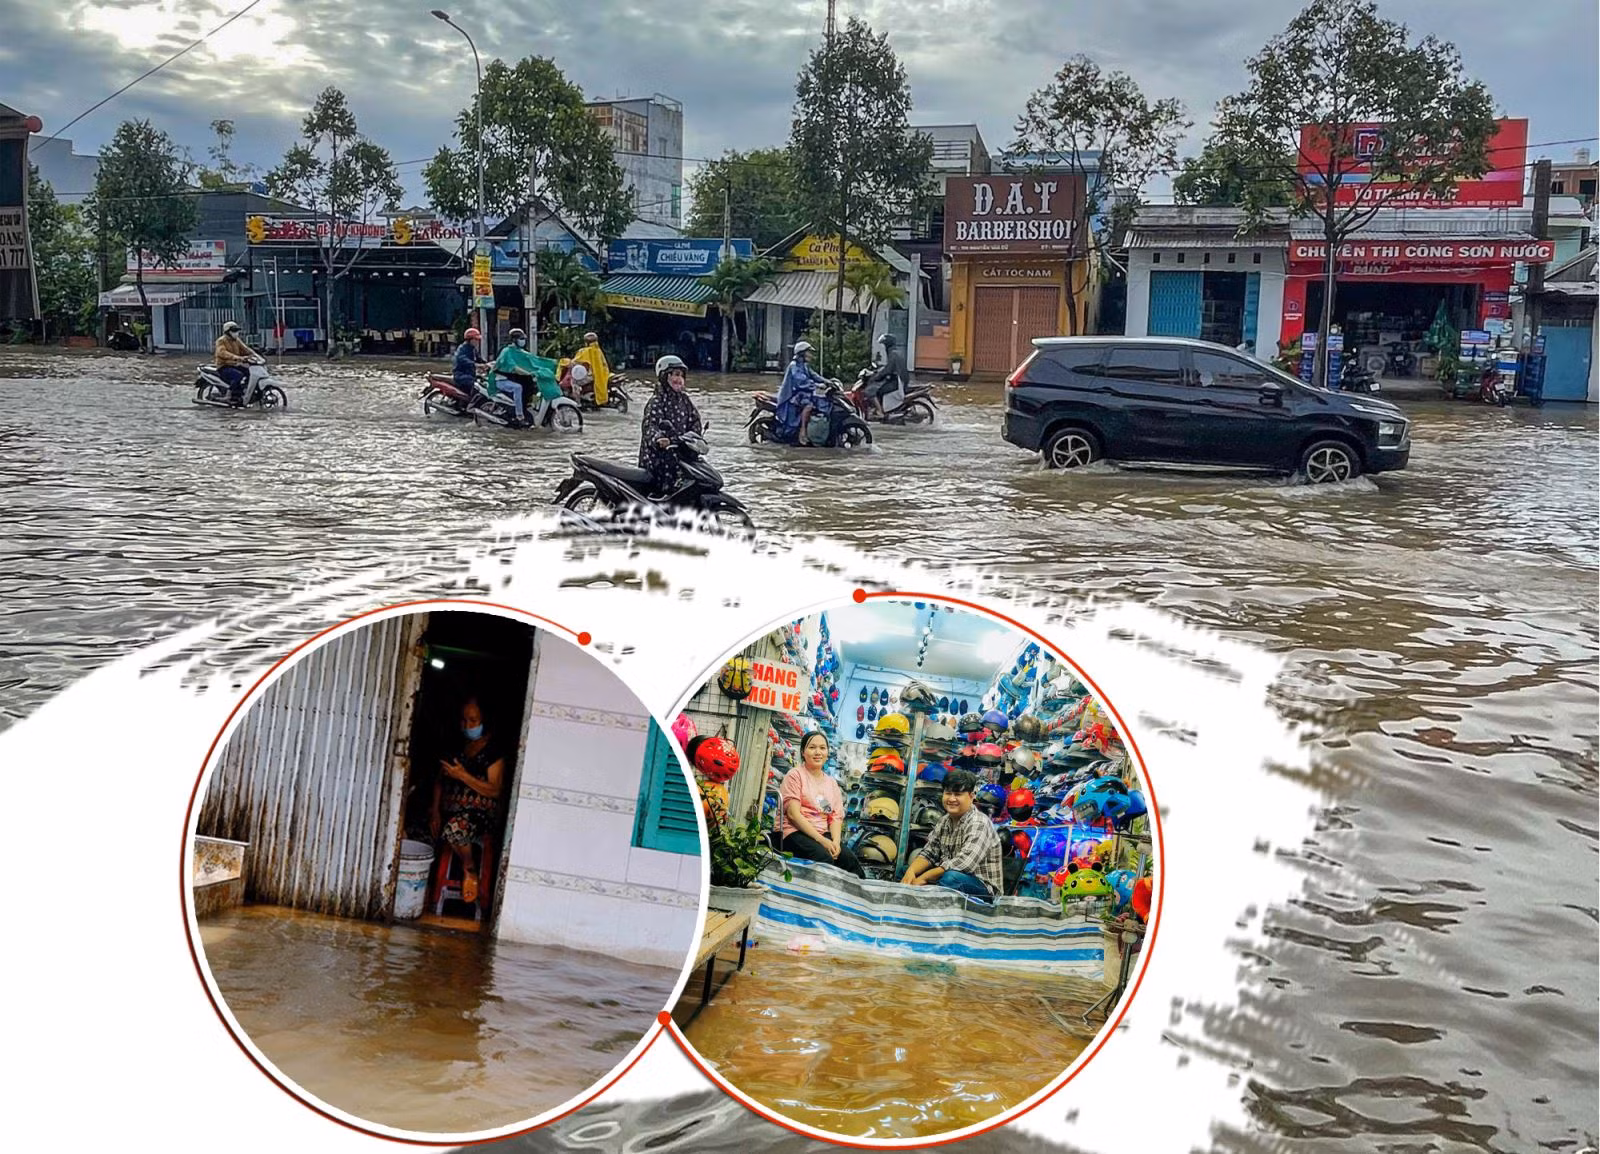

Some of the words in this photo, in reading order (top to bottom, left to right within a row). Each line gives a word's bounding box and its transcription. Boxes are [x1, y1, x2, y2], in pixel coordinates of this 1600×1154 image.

[972, 181, 1058, 215] D.A.T
[955, 219, 1077, 241] BARBERSHOP
[1371, 245, 1400, 258] THI
[1404, 243, 1454, 258] CÔNG
[1458, 244, 1495, 258] SƠN
[1500, 243, 1551, 258] NƯỚC
[1026, 268, 1052, 277] NAM
[752, 662, 797, 688] HÀNG
[781, 690, 801, 712] VỀ
